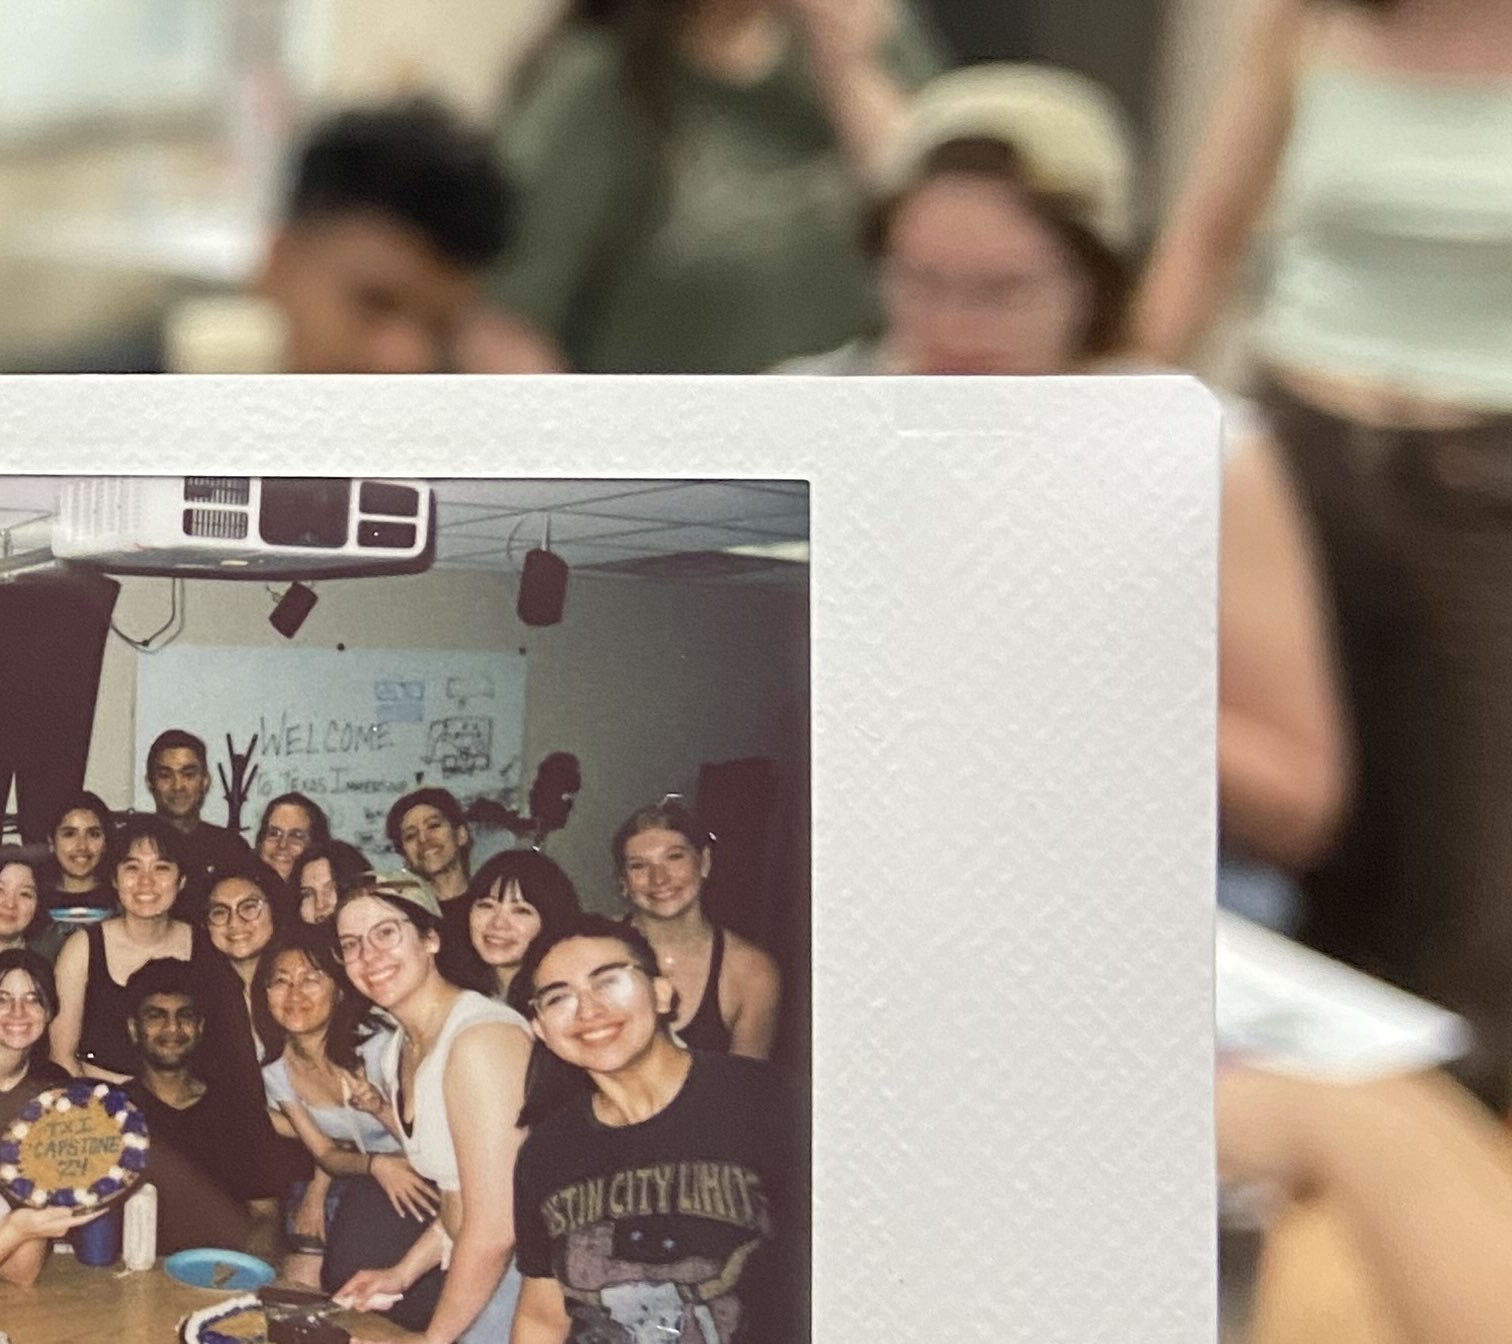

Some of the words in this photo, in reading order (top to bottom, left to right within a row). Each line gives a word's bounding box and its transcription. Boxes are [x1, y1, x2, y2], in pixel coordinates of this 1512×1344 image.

[259, 711, 395, 757] WELCOME
[33, 1135, 122, 1160] CAPSTONE
[540, 1177, 605, 1239] STIN
[609, 1163, 675, 1219] CITY
